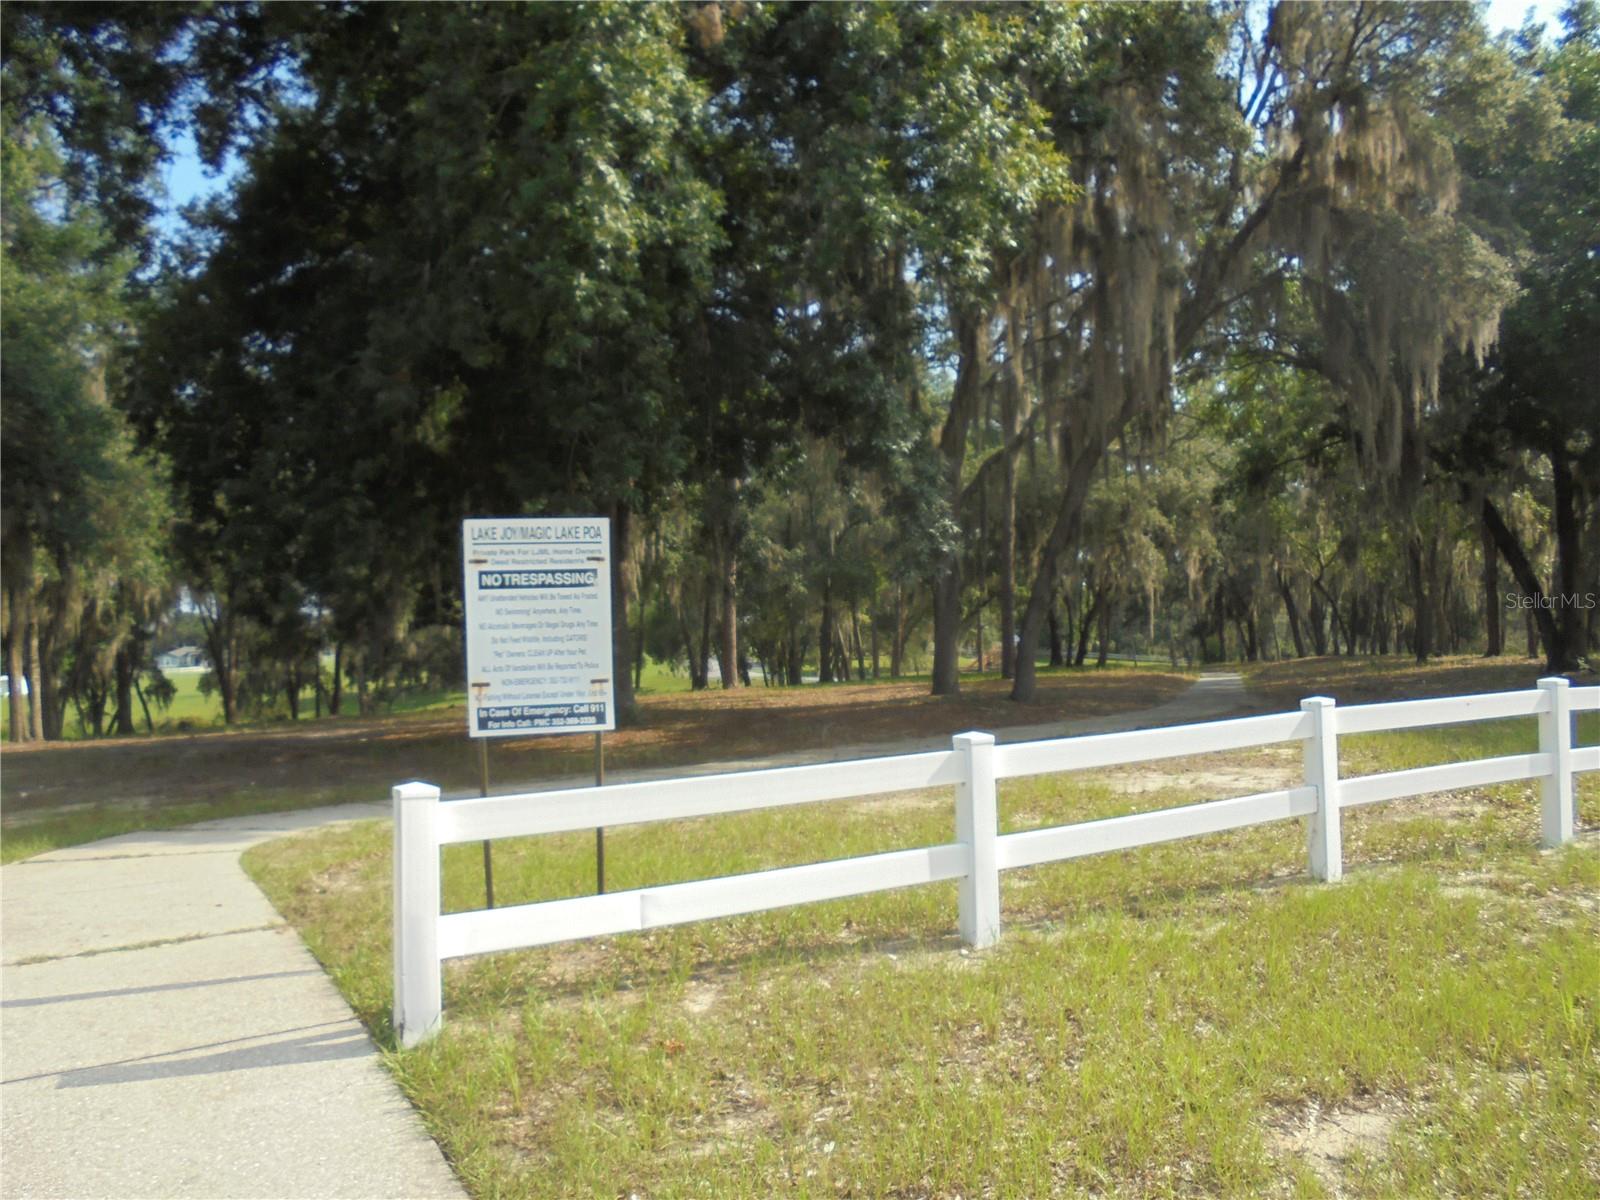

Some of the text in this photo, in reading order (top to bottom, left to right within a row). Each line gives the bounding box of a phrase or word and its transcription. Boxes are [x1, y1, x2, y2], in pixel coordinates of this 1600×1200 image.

[472, 527, 496, 540] LAKE
[555, 526, 580, 539] LAKE
[584, 526, 602, 539] POA
[482, 572, 594, 586] NO TRESPASSING
[489, 709, 509, 717] Case
[512, 708, 521, 716] Of
